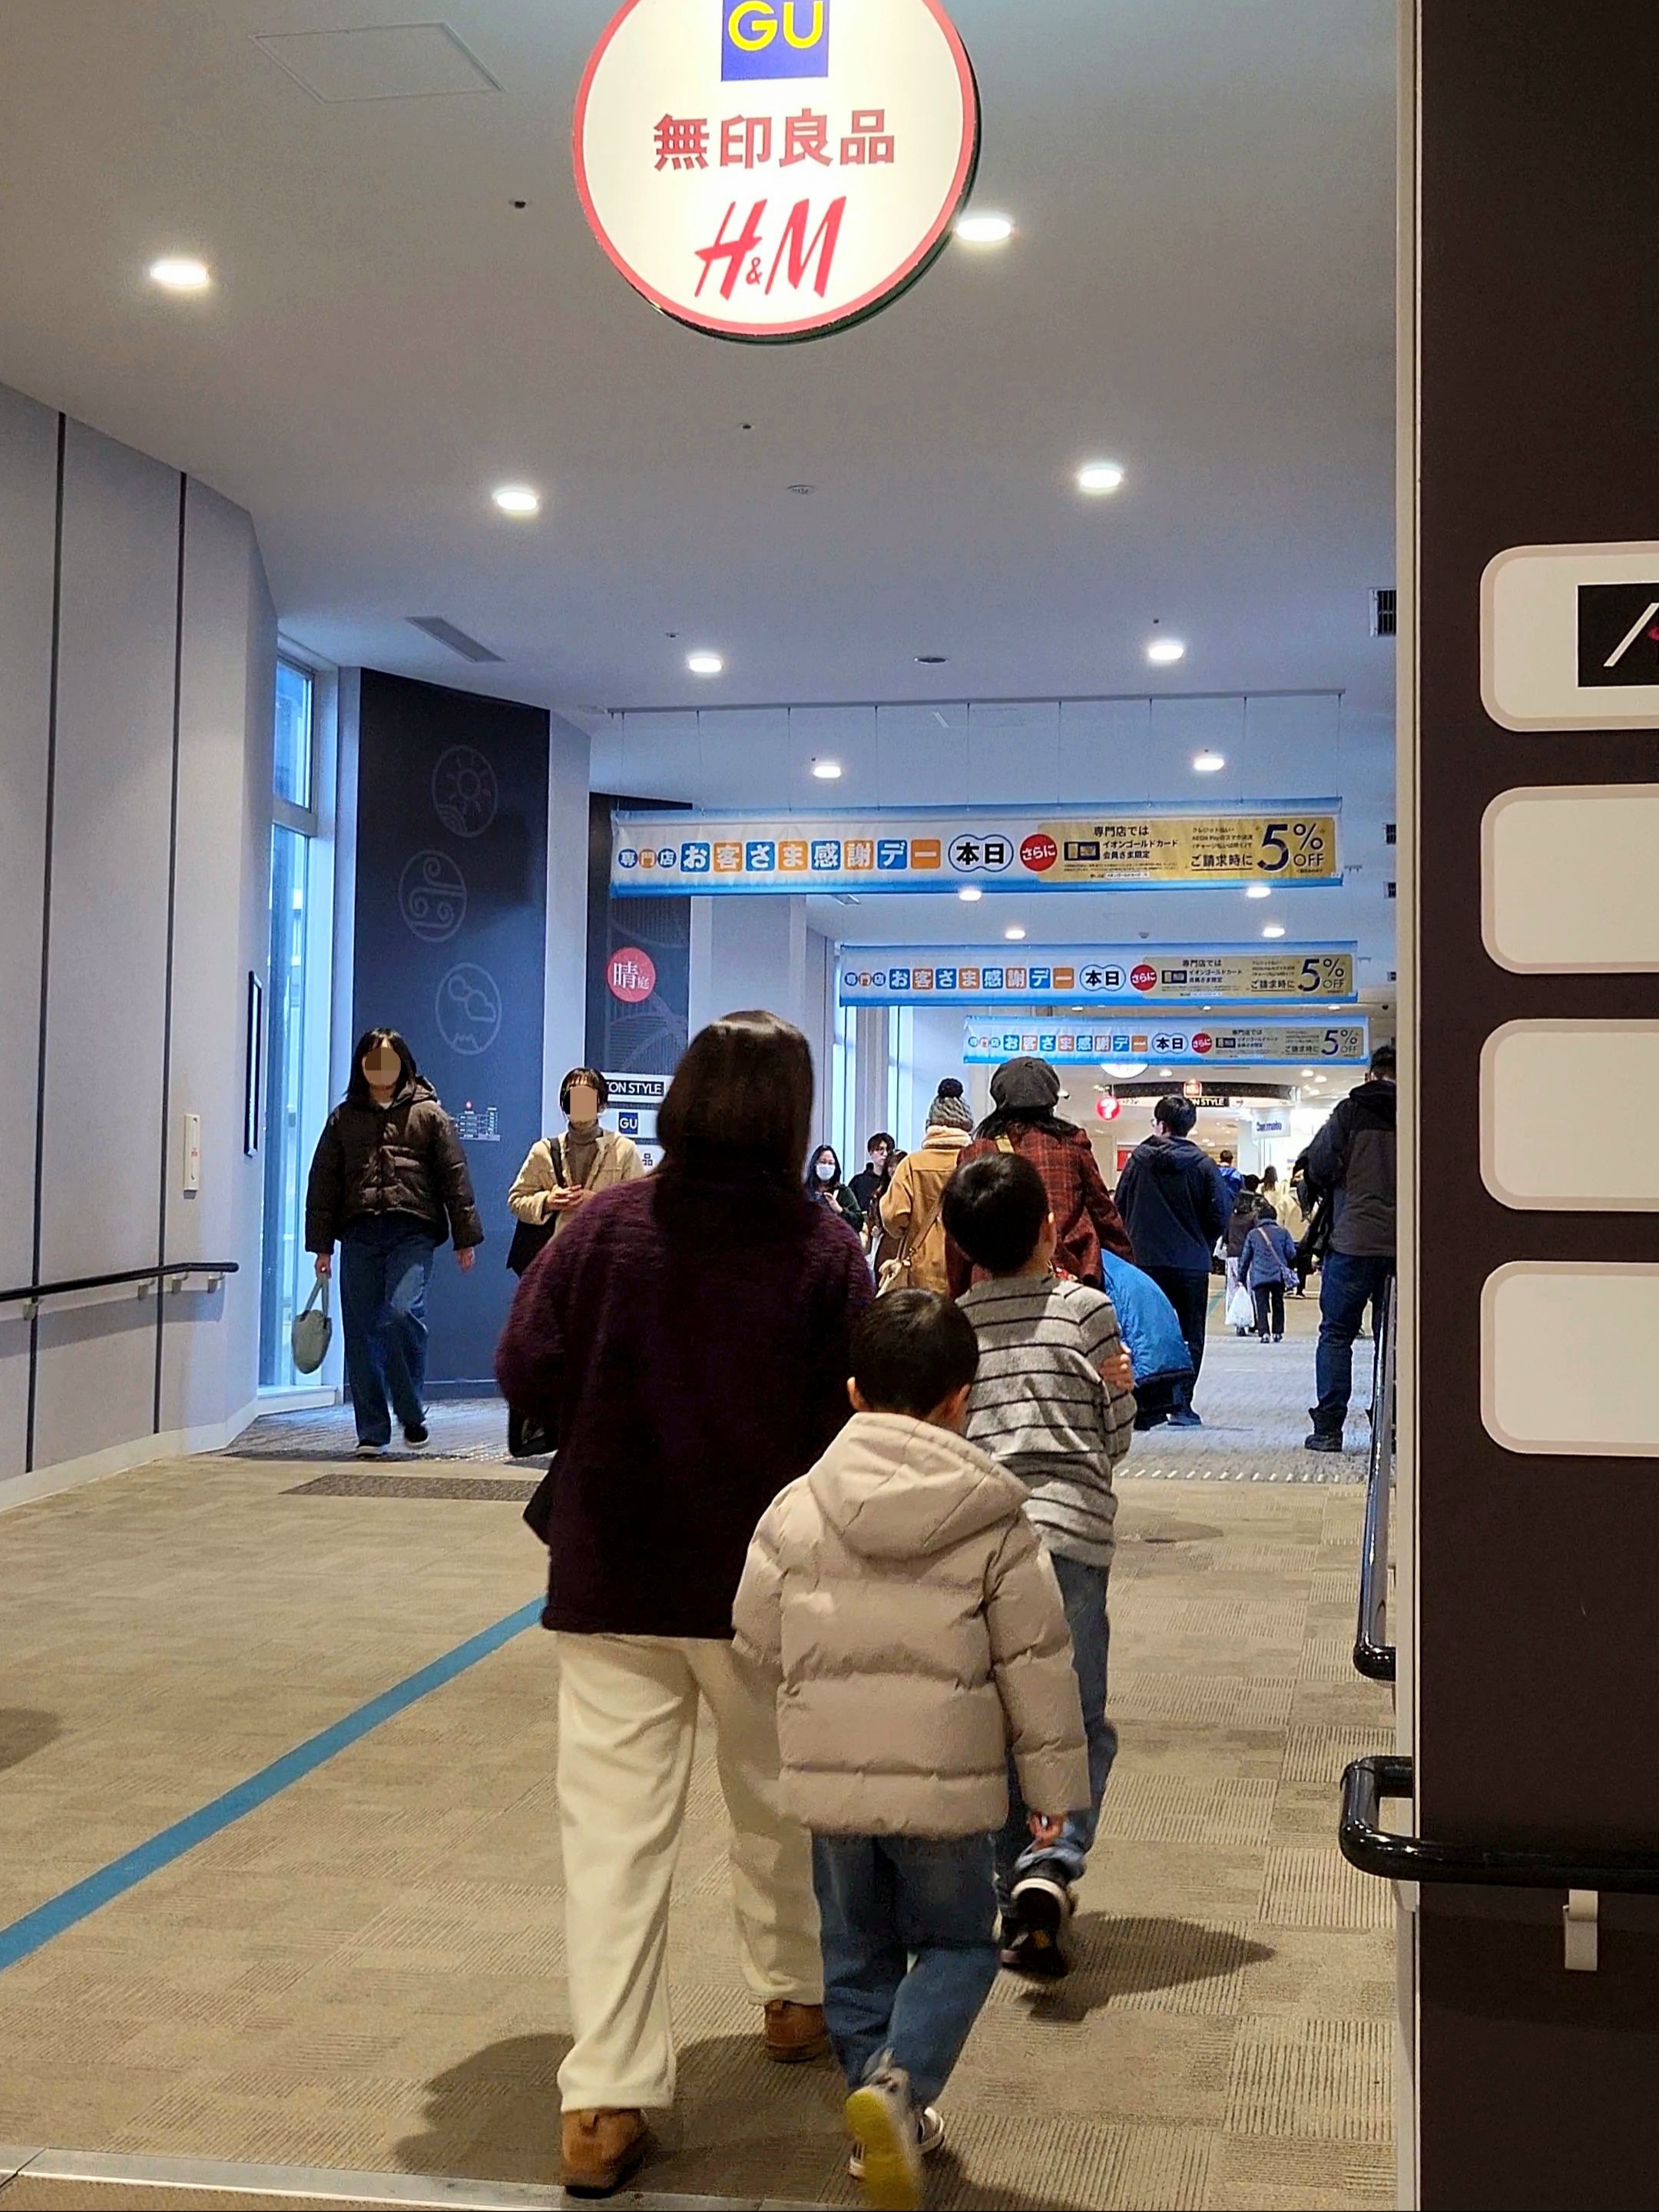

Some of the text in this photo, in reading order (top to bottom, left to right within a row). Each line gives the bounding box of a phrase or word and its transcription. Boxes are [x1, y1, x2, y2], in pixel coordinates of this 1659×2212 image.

[727, 0, 823, 51] GU
[653, 108, 895, 171] 無印良品
[694, 196, 846, 300] H&M
[1094, 826, 1149, 837] 専門店では
[1103, 839, 1178, 849] イオンゴールドカード
[1257, 823, 1324, 871] 5% OFF
[619, 841, 1056, 869] 専門店 お客さま感謝デー 本日 さらに
[1103, 850, 1150, 859] 会員さま限定
[1191, 854, 1253, 867] ご請求時に
[891, 969, 1073, 988] お客さま感謝デー
[1085, 970, 1119, 986] 本日
[1131, 972, 1157, 982] さらに
[1297, 958, 1344, 992] 5% OFF
[1004, 1035, 1147, 1051] お客さま感謝デー
[1156, 1037, 1184, 1050] 本日
[1192, 1038, 1211, 1048] さらに
[1321, 1029, 1357, 1055] 5%
[606, 1081, 662, 1095] ON STYLE
[619, 1118, 638, 1129] GU
